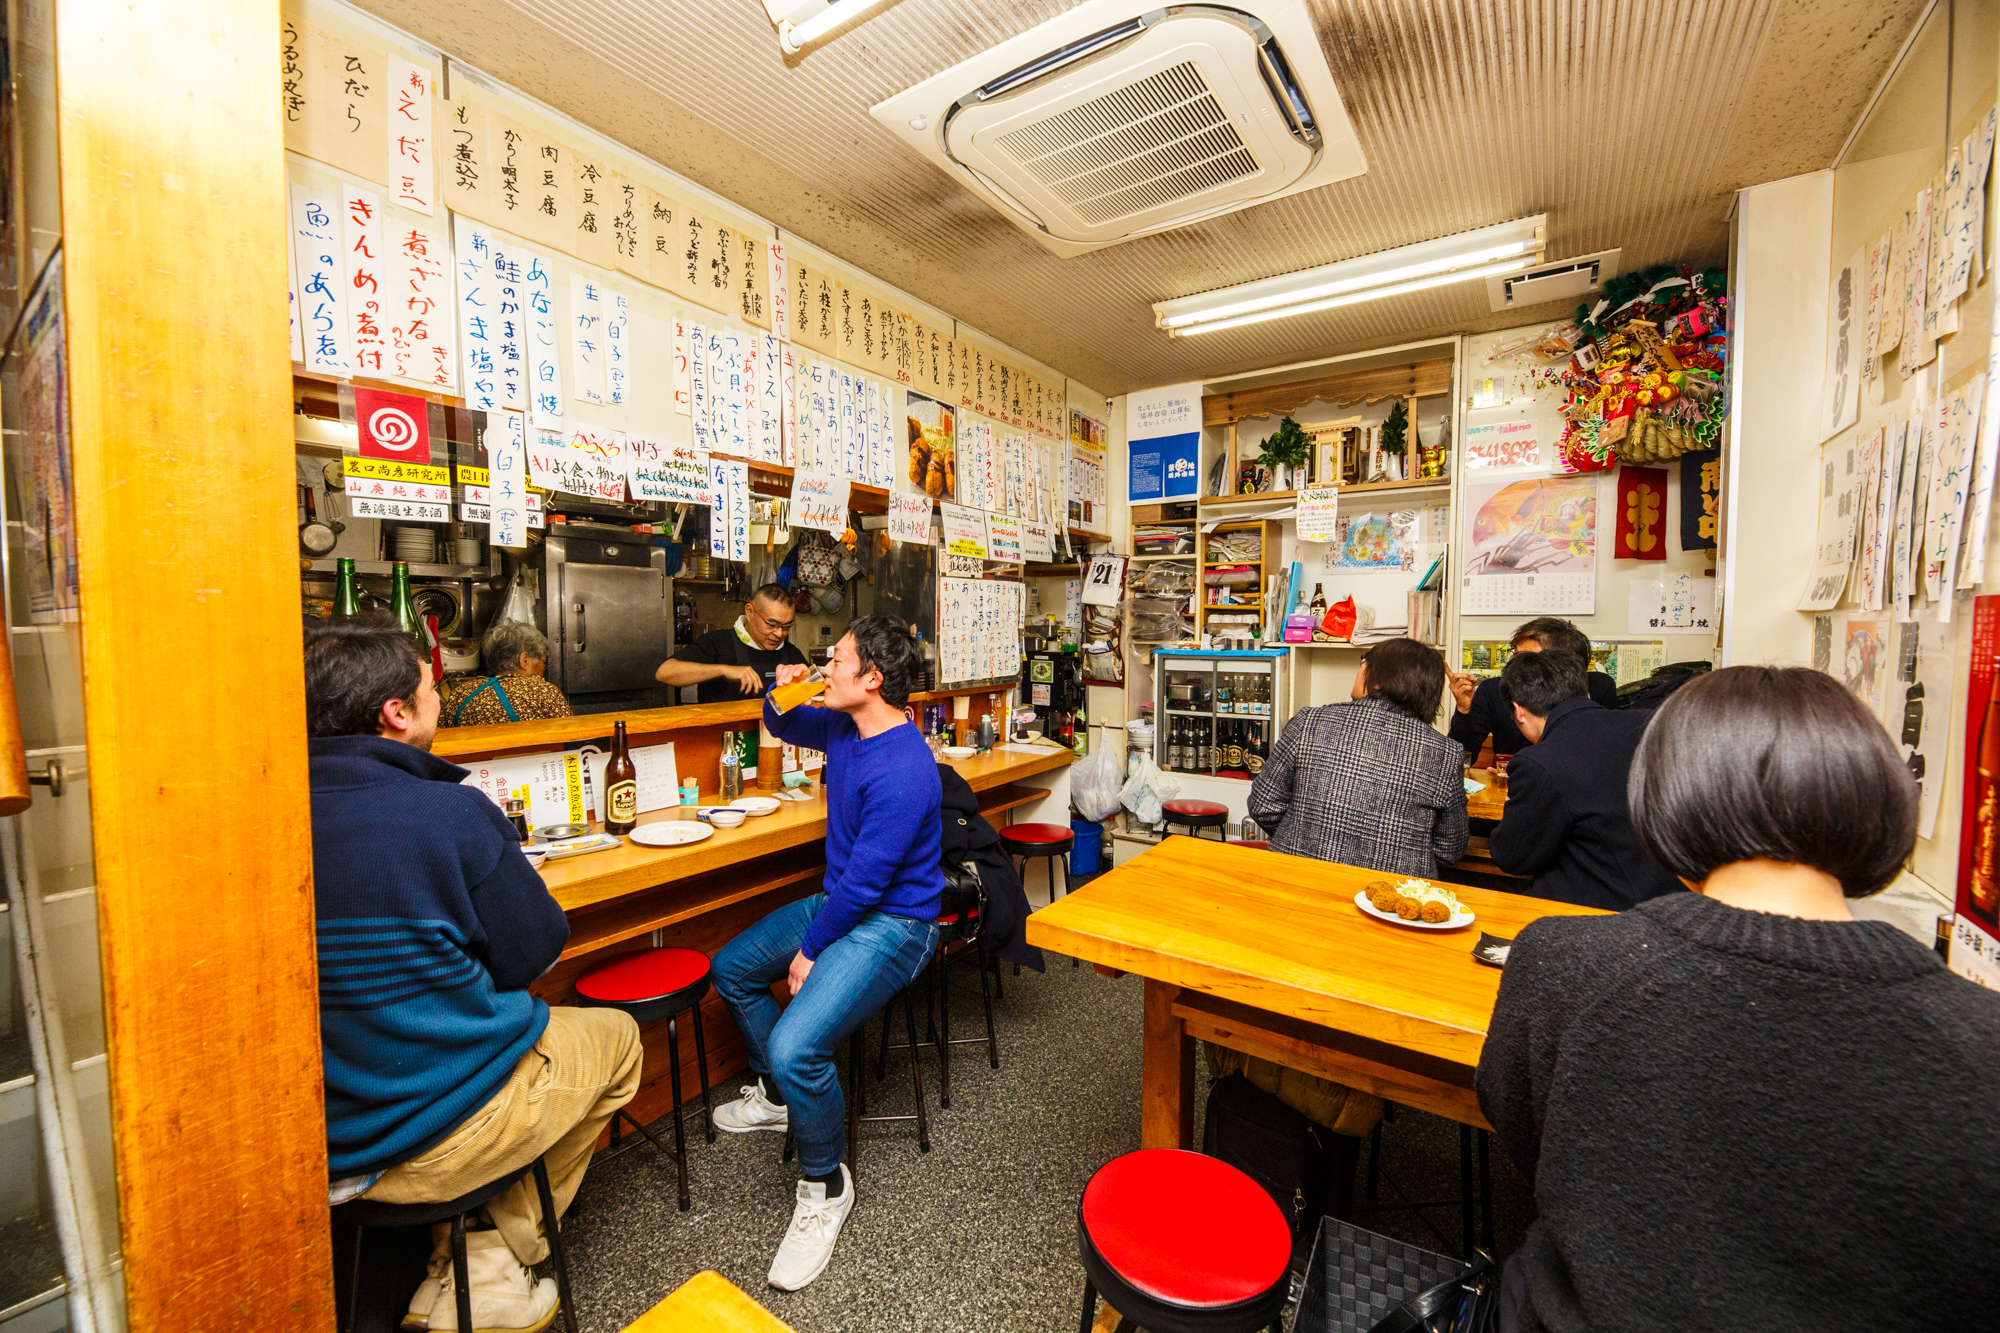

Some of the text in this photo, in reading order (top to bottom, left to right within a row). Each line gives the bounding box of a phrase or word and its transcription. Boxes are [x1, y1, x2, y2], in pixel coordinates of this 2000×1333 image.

[344, 55, 370, 133] ひだら
[453, 105, 479, 191] もつ煮込み
[501, 129, 522, 210] からし明太子
[538, 146, 558, 217] 肉豆腐
[578, 164, 602, 234] 冷豆腐
[613, 216, 625, 254] おろし
[622, 184, 638, 258] ちりめんじゃこ
[652, 201, 672, 255] 納豆
[299, 202, 350, 368] 魚のあら煮
[349, 198, 386, 370] きんめの煮付
[402, 230, 442, 340] 煮ざかな
[710, 257, 721, 288] 新香
[770, 244, 787, 338] せりのひたし
[798, 268, 809, 333] まいたけ天ぷら
[460, 231, 495, 411] 新さんま塩やき
[494, 252, 521, 399] 鮭のかま塩やき
[526, 258, 564, 417] あなご白焼
[577, 284, 599, 363] 生がき
[842, 288, 855, 348] きす天ぷら
[860, 298, 874, 356] あなご天ぷら
[879, 310, 889, 362] ポテトサラダ
[896, 314, 908, 337] いか
[391, 327, 411, 376] のどぐろ
[431, 346, 449, 385] きんき
[674, 322, 690, 404] 生うに
[708, 335, 723, 385] あじ
[764, 334, 779, 398] さざえ
[896, 369, 911, 384] 550
[902, 338, 912, 370] 天ぷら
[915, 324, 925, 377] あじフライ
[961, 347, 970, 393] オムレツ
[725, 337, 745, 447] つぶ貝さしみ
[743, 357, 757, 409] あわび
[784, 351, 796, 460] まぐろさしみ
[961, 395, 973, 406] 500
[988, 359, 998, 404] とんかつ
[1025, 377, 1034, 419] チャーハン
[570, 430, 621, 459] からくち
[718, 396, 729, 438] さしみ
[762, 411, 771, 460] つぼやき
[771, 418, 779, 460] さしみ
[799, 363, 812, 471] ひらめさしみ
[840, 375, 855, 477] ほうぼうのさしみ
[867, 386, 881, 486] かわはぎさしみ
[882, 389, 894, 487] くえのさしみ
[1497, 423, 1531, 434] takeno
[348, 460, 447, 482] 農口尚彦研究所
[350, 481, 448, 500] 山廃純米酒
[532, 454, 625, 483] キレよく食べ物との
[984, 427, 994, 504] ほうぼう天ぷら
[1935, 398, 1965, 562] ひらめさしみ
[358, 502, 443, 519] 無濾過生原酒
[713, 464, 727, 555] なまこ酢
[730, 465, 748, 560] さざえつぼやき
[992, 527, 1018, 537] ウーロンハイ
[1092, 564, 1113, 584] 21
[952, 583, 960, 629] いわし
[962, 582, 969, 627] あじ
[567, 754, 583, 822] 本日の煮魚定食
